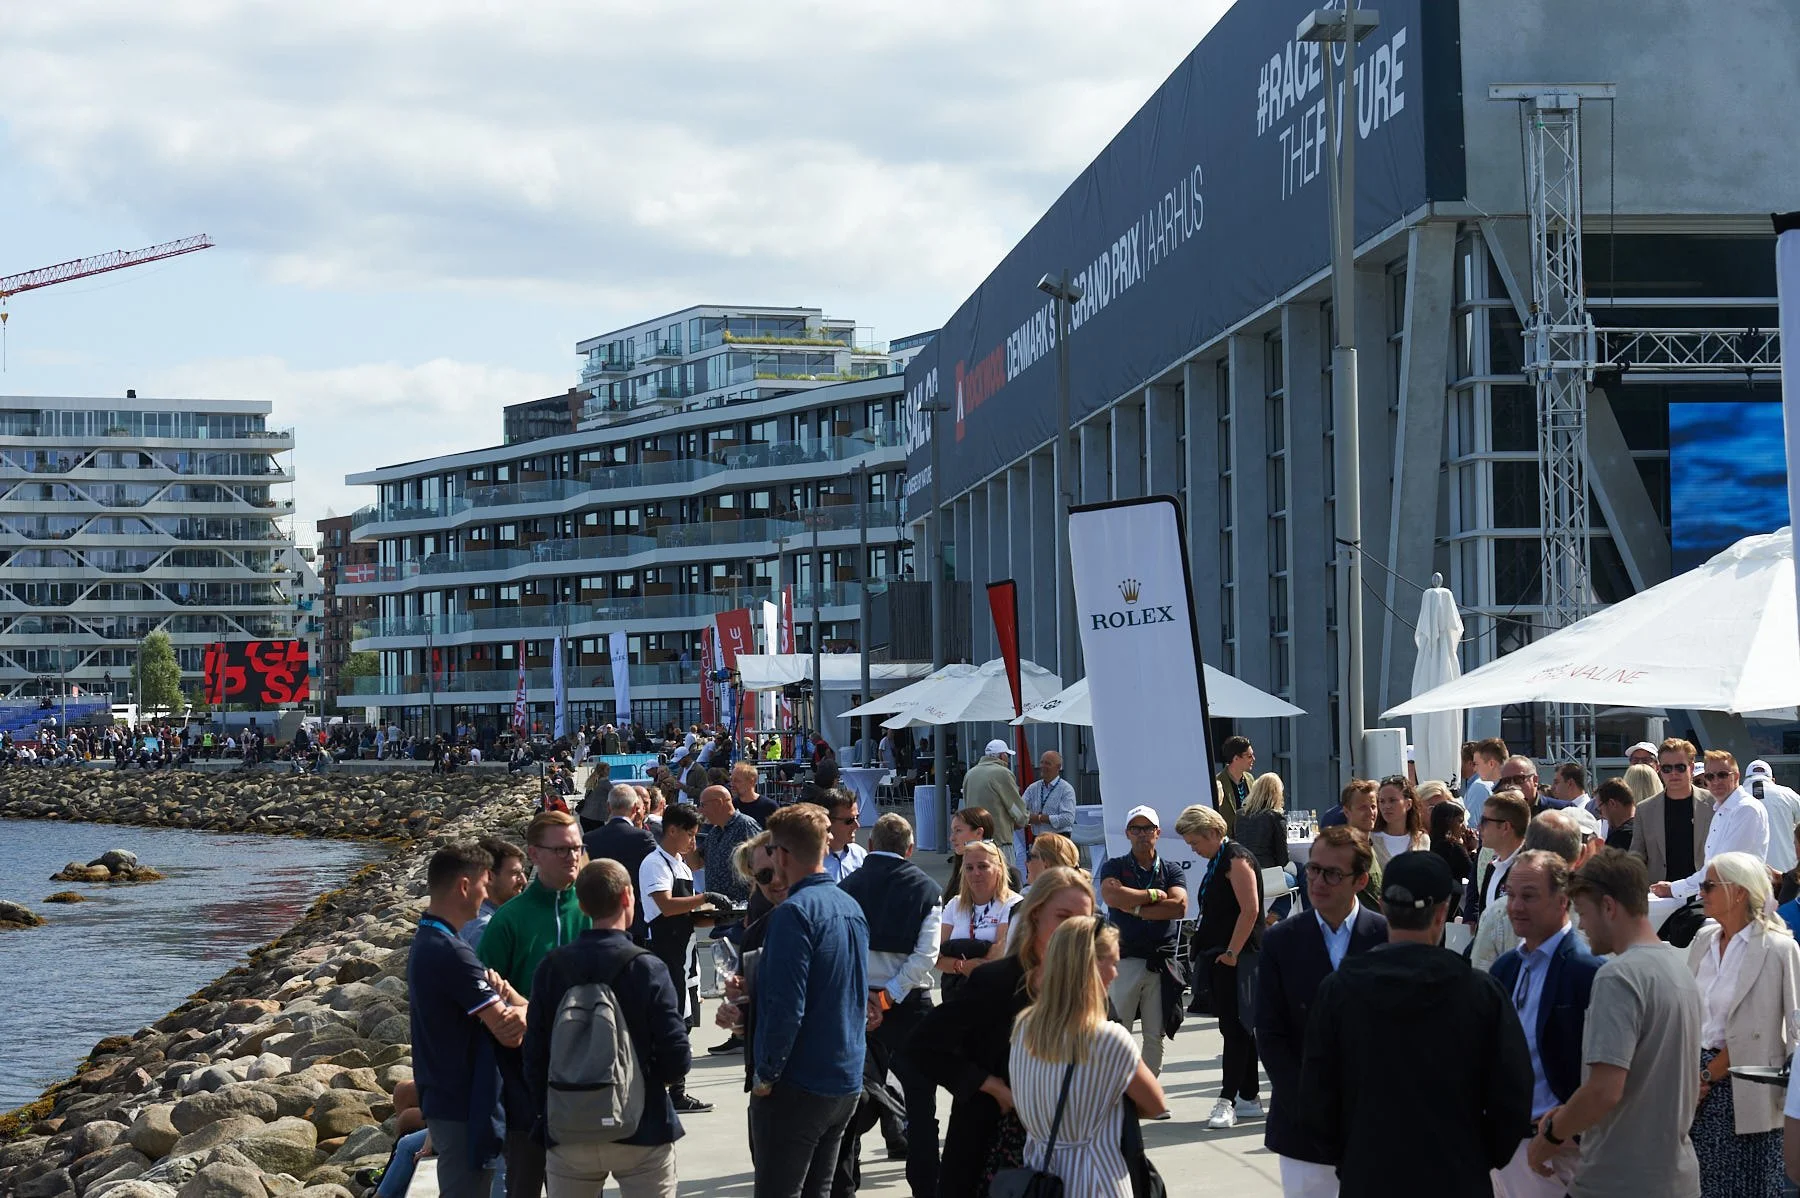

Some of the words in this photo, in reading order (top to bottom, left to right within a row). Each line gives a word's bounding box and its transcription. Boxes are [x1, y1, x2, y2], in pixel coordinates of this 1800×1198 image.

[1257, 0, 1361, 137] #RACEFO
[1006, 304, 1049, 383] DENMARK
[1072, 251, 1110, 330] GRAND
[1112, 221, 1141, 300] PRIX
[1147, 164, 1204, 271] AARHUS
[1091, 605, 1175, 631] ROLEX
